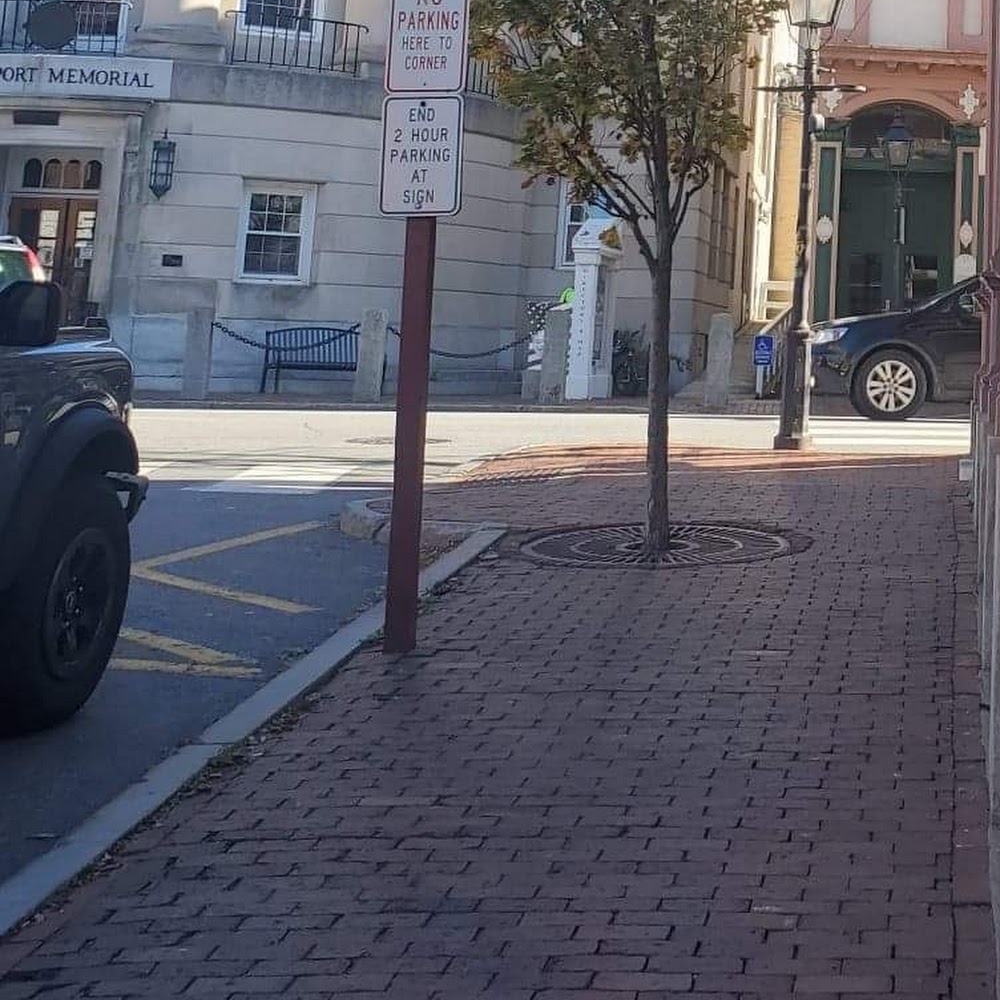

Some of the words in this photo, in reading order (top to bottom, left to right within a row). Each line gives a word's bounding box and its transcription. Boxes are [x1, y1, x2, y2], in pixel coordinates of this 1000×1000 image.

[398, 11, 460, 31] PARKING
[402, 36, 430, 51] HERE
[439, 36, 453, 50] TO
[404, 55, 448, 71] CORNER
[0, 67, 39, 83] ORT
[48, 67, 154, 88] MEMORIAL
[409, 107, 435, 122] END
[394, 128, 403, 143] 2
[411, 127, 449, 142] HOUR
[390, 147, 451, 163] PARKING
[411, 168, 428, 183] AT
[403, 189, 435, 204] SIGN
